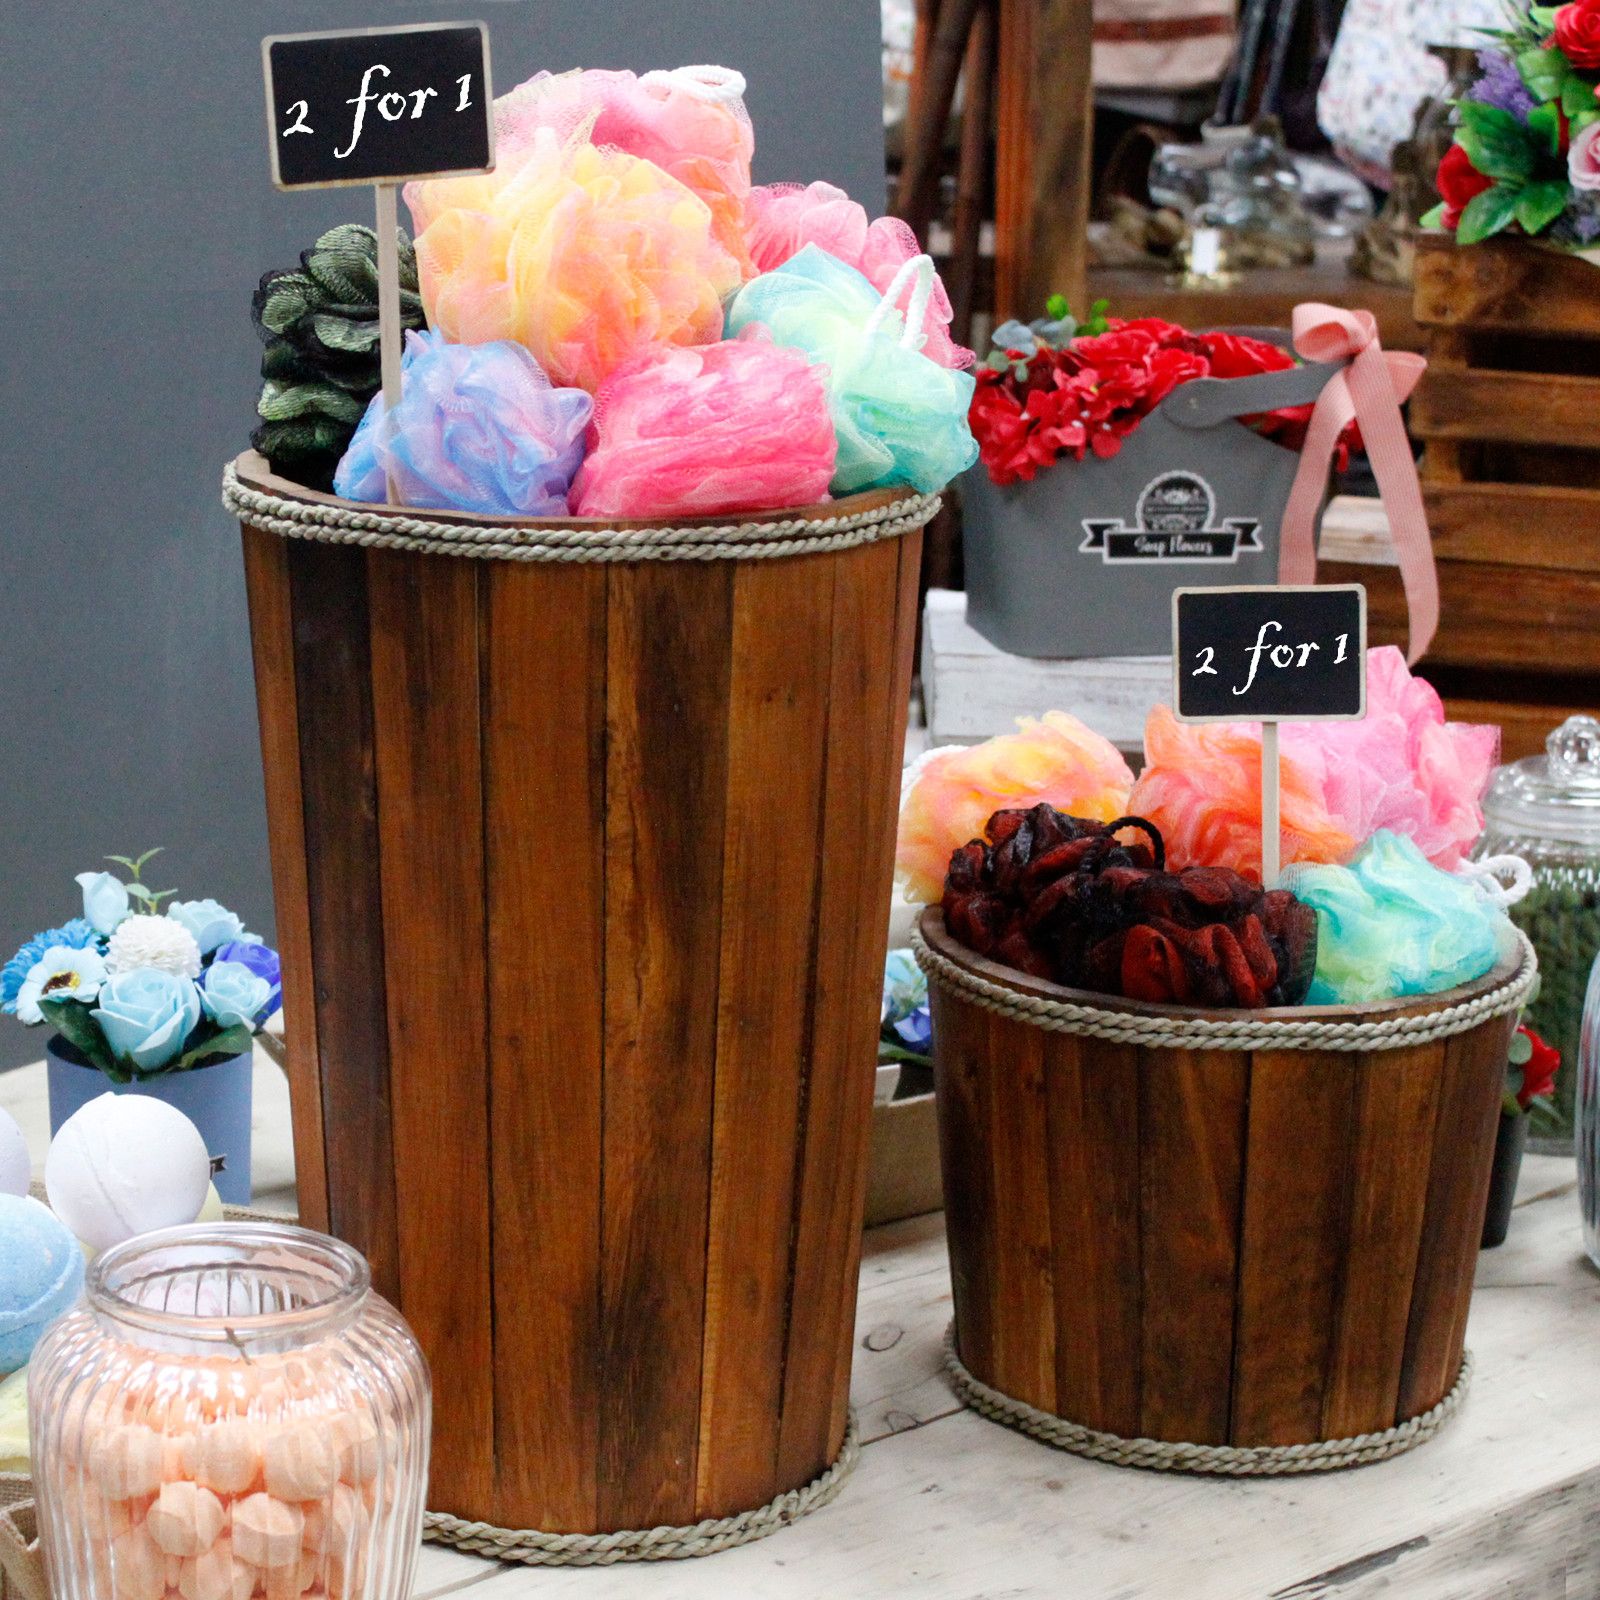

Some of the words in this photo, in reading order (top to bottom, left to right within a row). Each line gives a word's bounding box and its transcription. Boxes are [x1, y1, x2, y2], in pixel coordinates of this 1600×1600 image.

[282, 99, 315, 138] 2
[333, 64, 438, 159] for
[455, 73, 473, 112] 1
[1134, 535, 1165, 559] Soap
[1191, 646, 1218, 677] 2
[1231, 620, 1320, 696] for
[1333, 633, 1349, 665] 1
